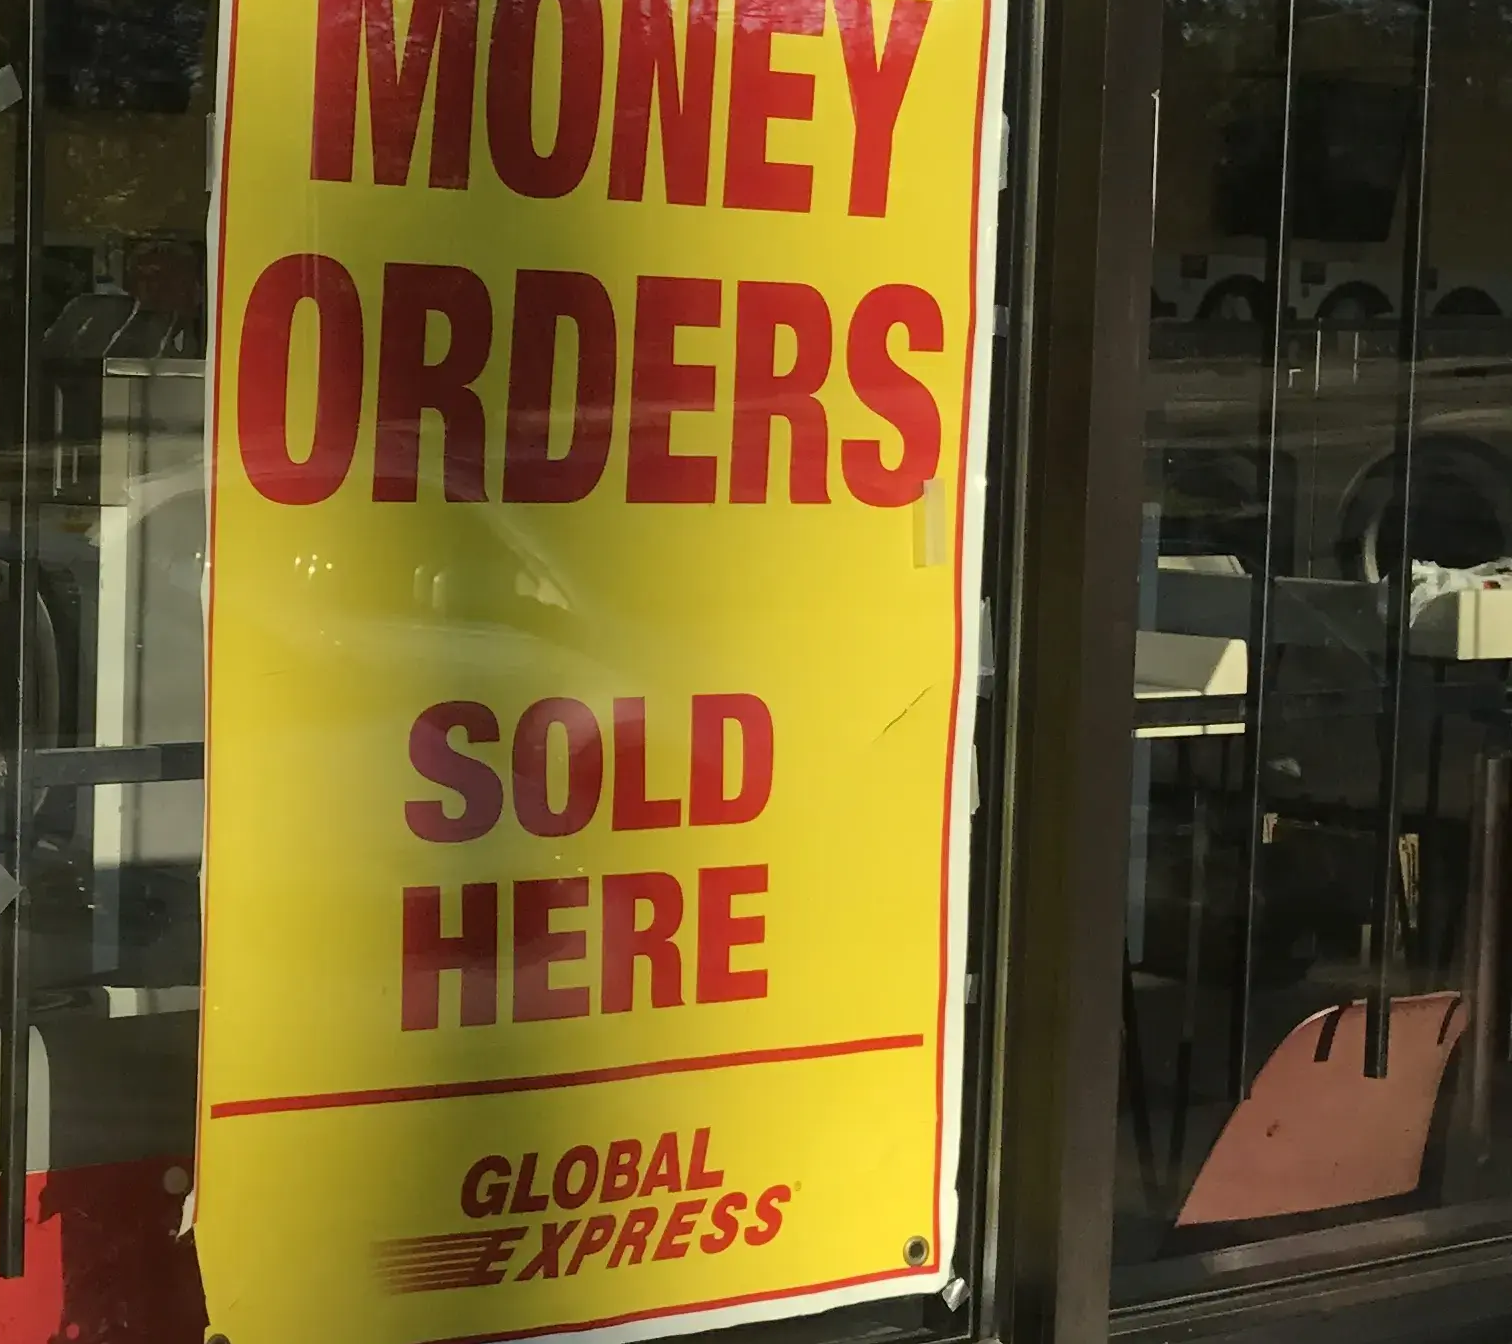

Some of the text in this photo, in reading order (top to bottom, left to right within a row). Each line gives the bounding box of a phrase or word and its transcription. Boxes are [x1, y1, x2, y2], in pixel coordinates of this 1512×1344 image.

[236, 253, 945, 508] ORDERS
[405, 693, 774, 843] SOLD
[402, 864, 769, 1031] HERE
[459, 1126, 725, 1220] GLOBAL
